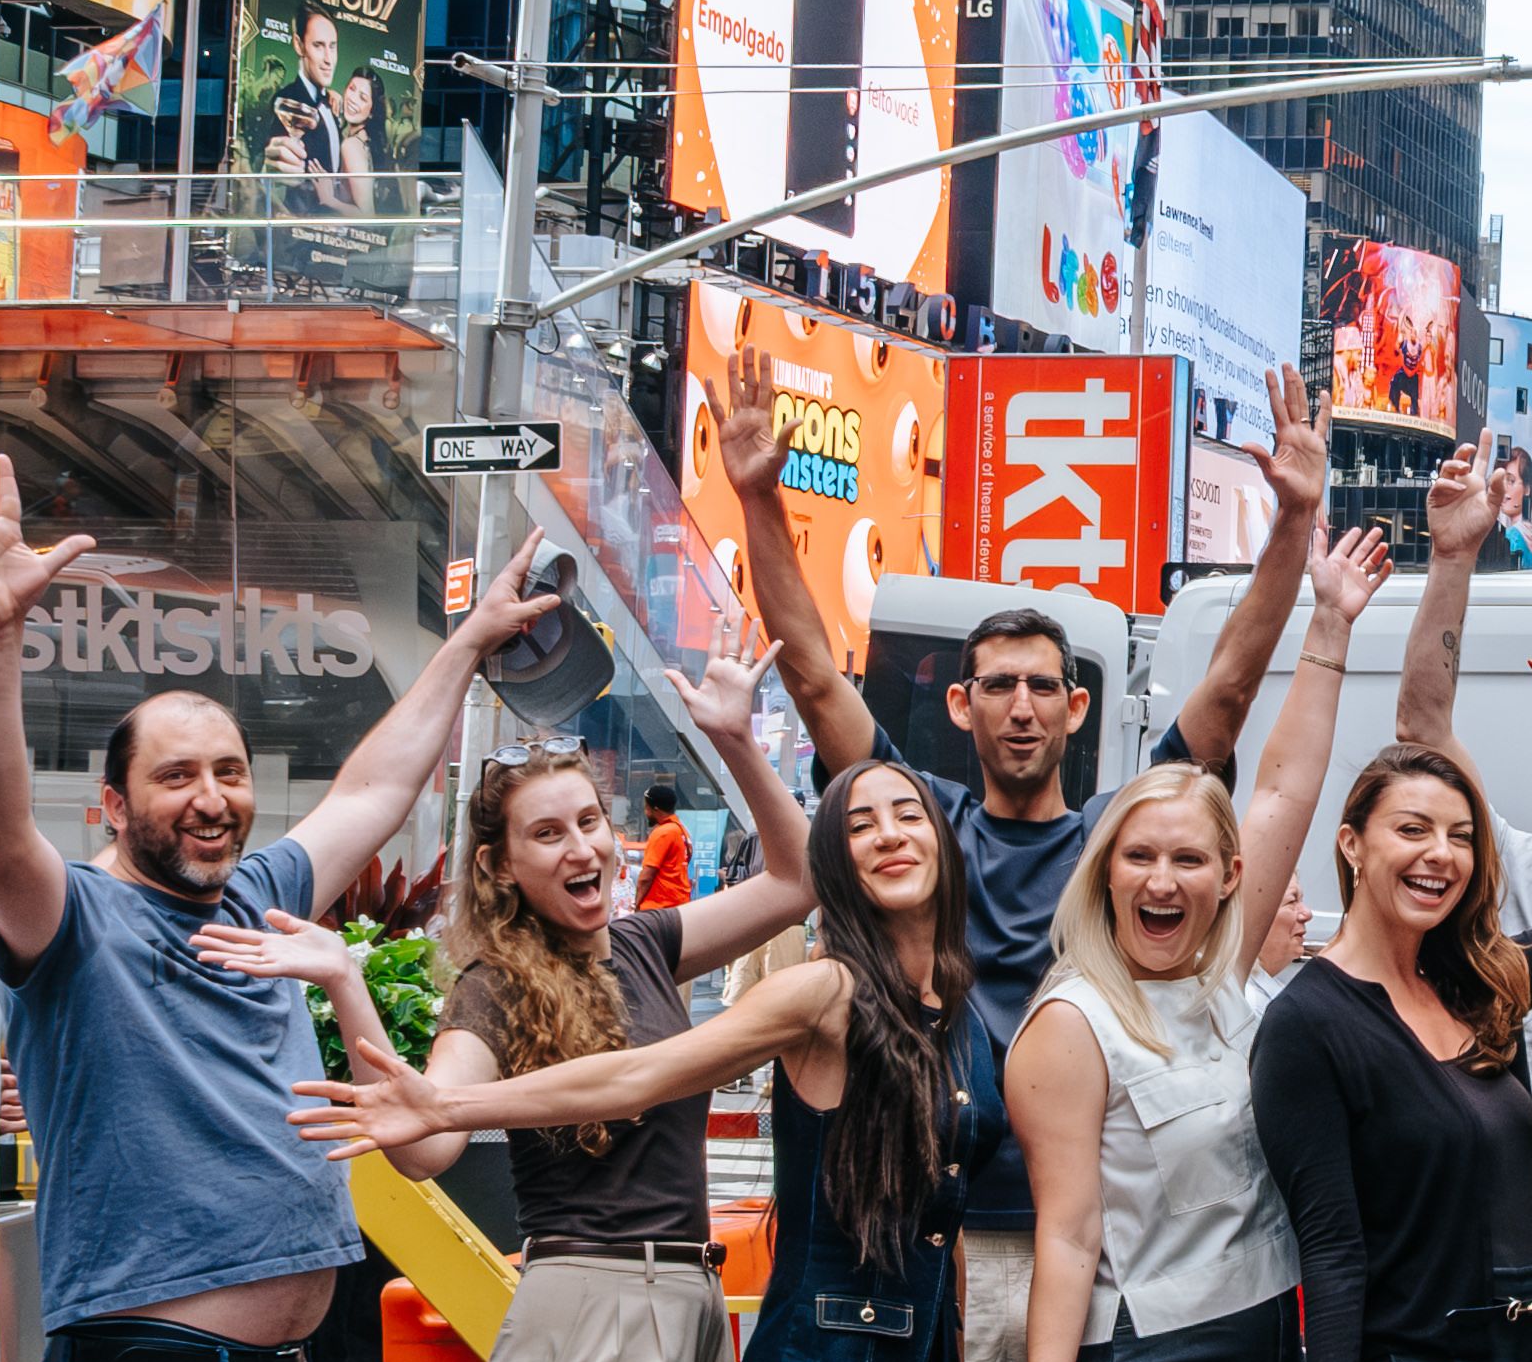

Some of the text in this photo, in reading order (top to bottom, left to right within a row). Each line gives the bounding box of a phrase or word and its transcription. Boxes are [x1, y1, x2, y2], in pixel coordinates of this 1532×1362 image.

[1159, 199, 1199, 231] Lawrence
[1123, 273, 1164, 307] ben
[1166, 285, 1205, 328] showing
[440, 438, 538, 459] ONE WAY
[983, 407, 996, 459] service
[981, 464, 995, 478] of
[980, 482, 995, 536] theatre
